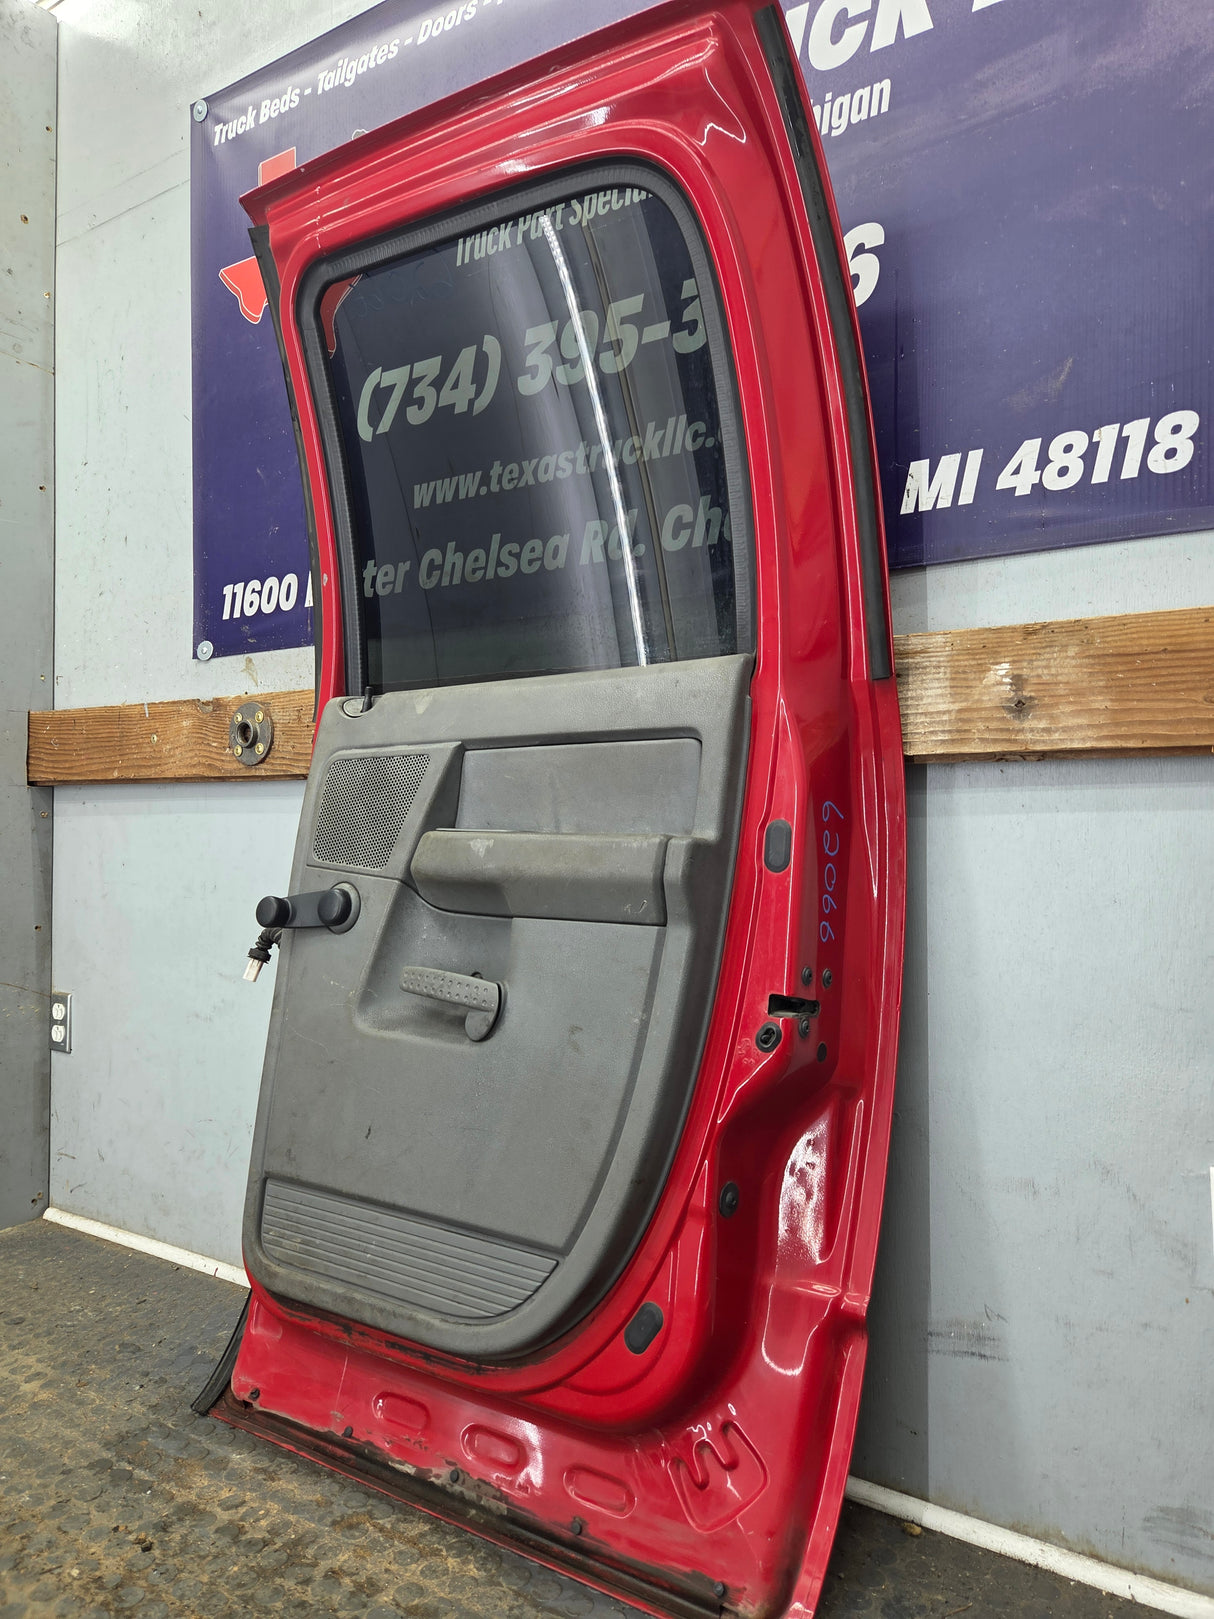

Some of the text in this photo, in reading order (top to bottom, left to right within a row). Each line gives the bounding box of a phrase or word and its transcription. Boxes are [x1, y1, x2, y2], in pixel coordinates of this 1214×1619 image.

[213, 105, 257, 146] Truck
[259, 86, 300, 125] Beds
[316, 38, 400, 95] Tailgates
[417, 0, 477, 45] Doors
[356, 334, 501, 442] (734)
[222, 573, 298, 620] 11600
[418, 533, 570, 589] Chelsea
[580, 508, 646, 565] Rd.
[900, 448, 984, 515] MI
[995, 410, 1200, 496] 48118
